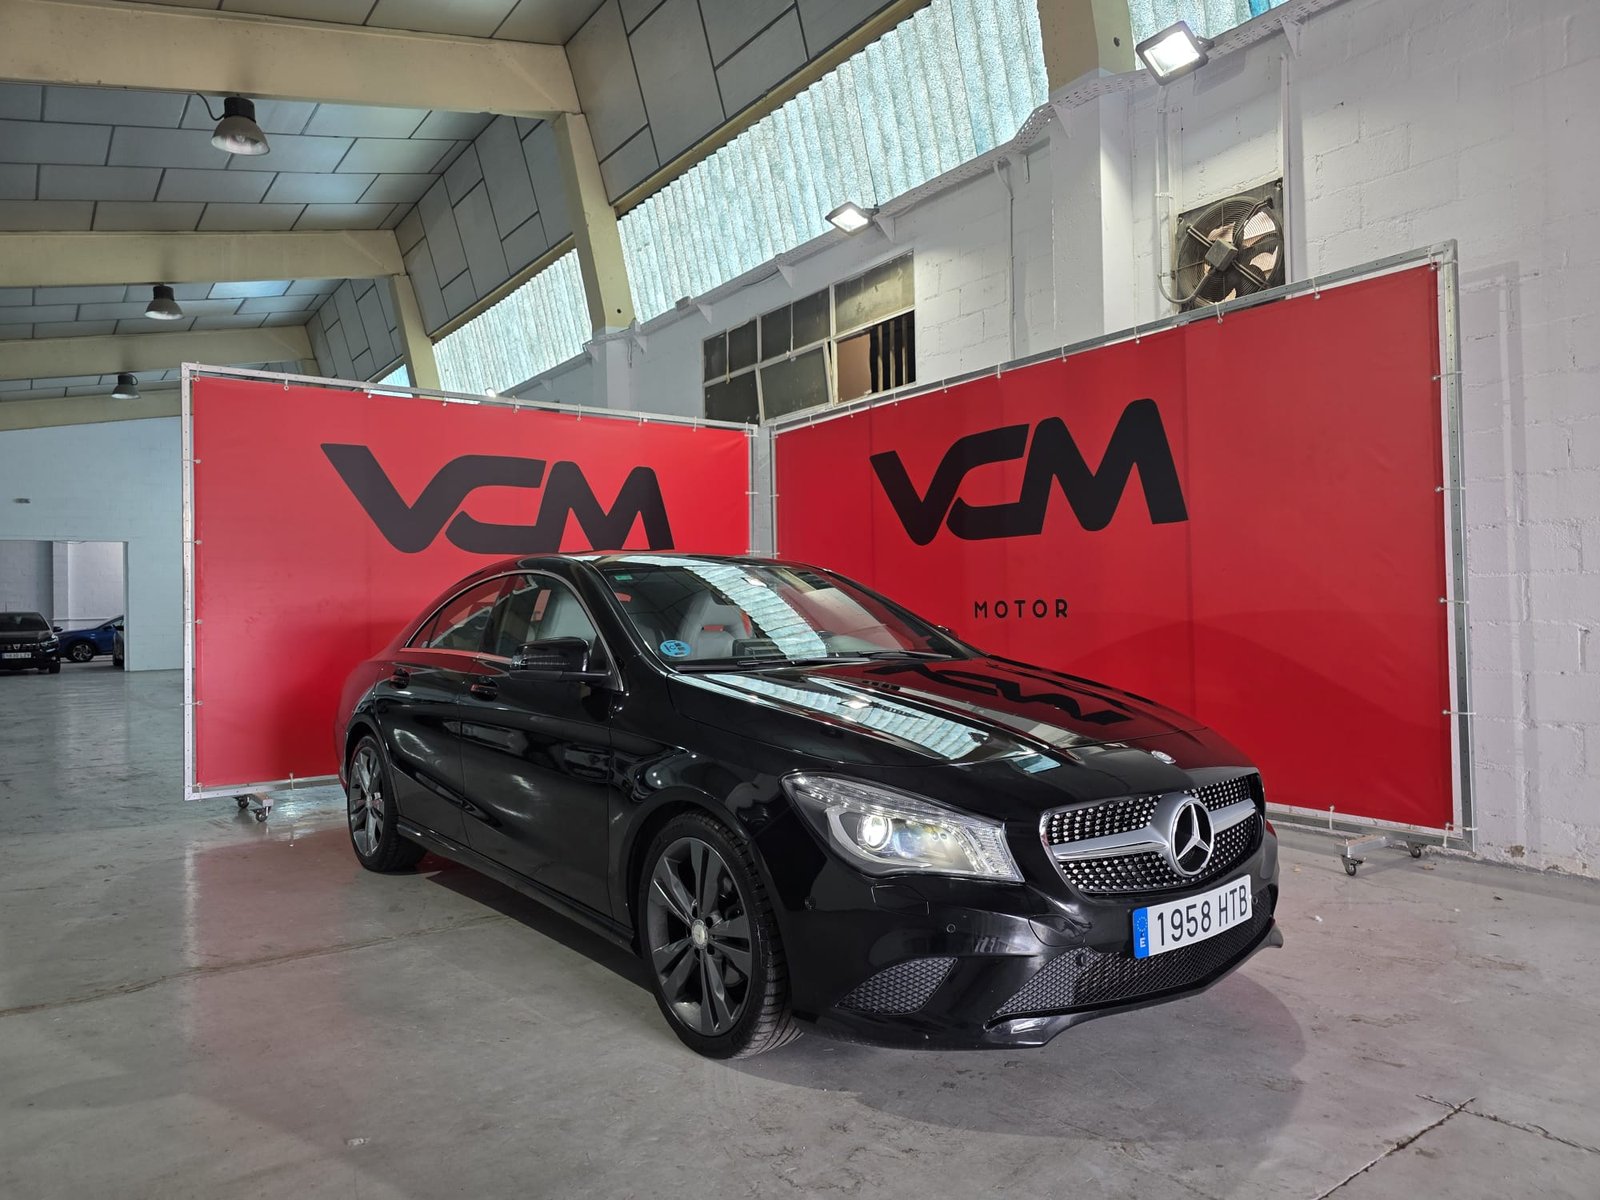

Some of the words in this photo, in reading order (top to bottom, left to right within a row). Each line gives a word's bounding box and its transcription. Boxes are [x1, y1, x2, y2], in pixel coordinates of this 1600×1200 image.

[320, 443, 675, 555] VCM
[869, 398, 1189, 546] VCM
[974, 599, 1068, 619] MOTOR
[1139, 937, 1147, 949] E
[1157, 900, 1212, 946] 1958
[1218, 884, 1248, 927] HTB
